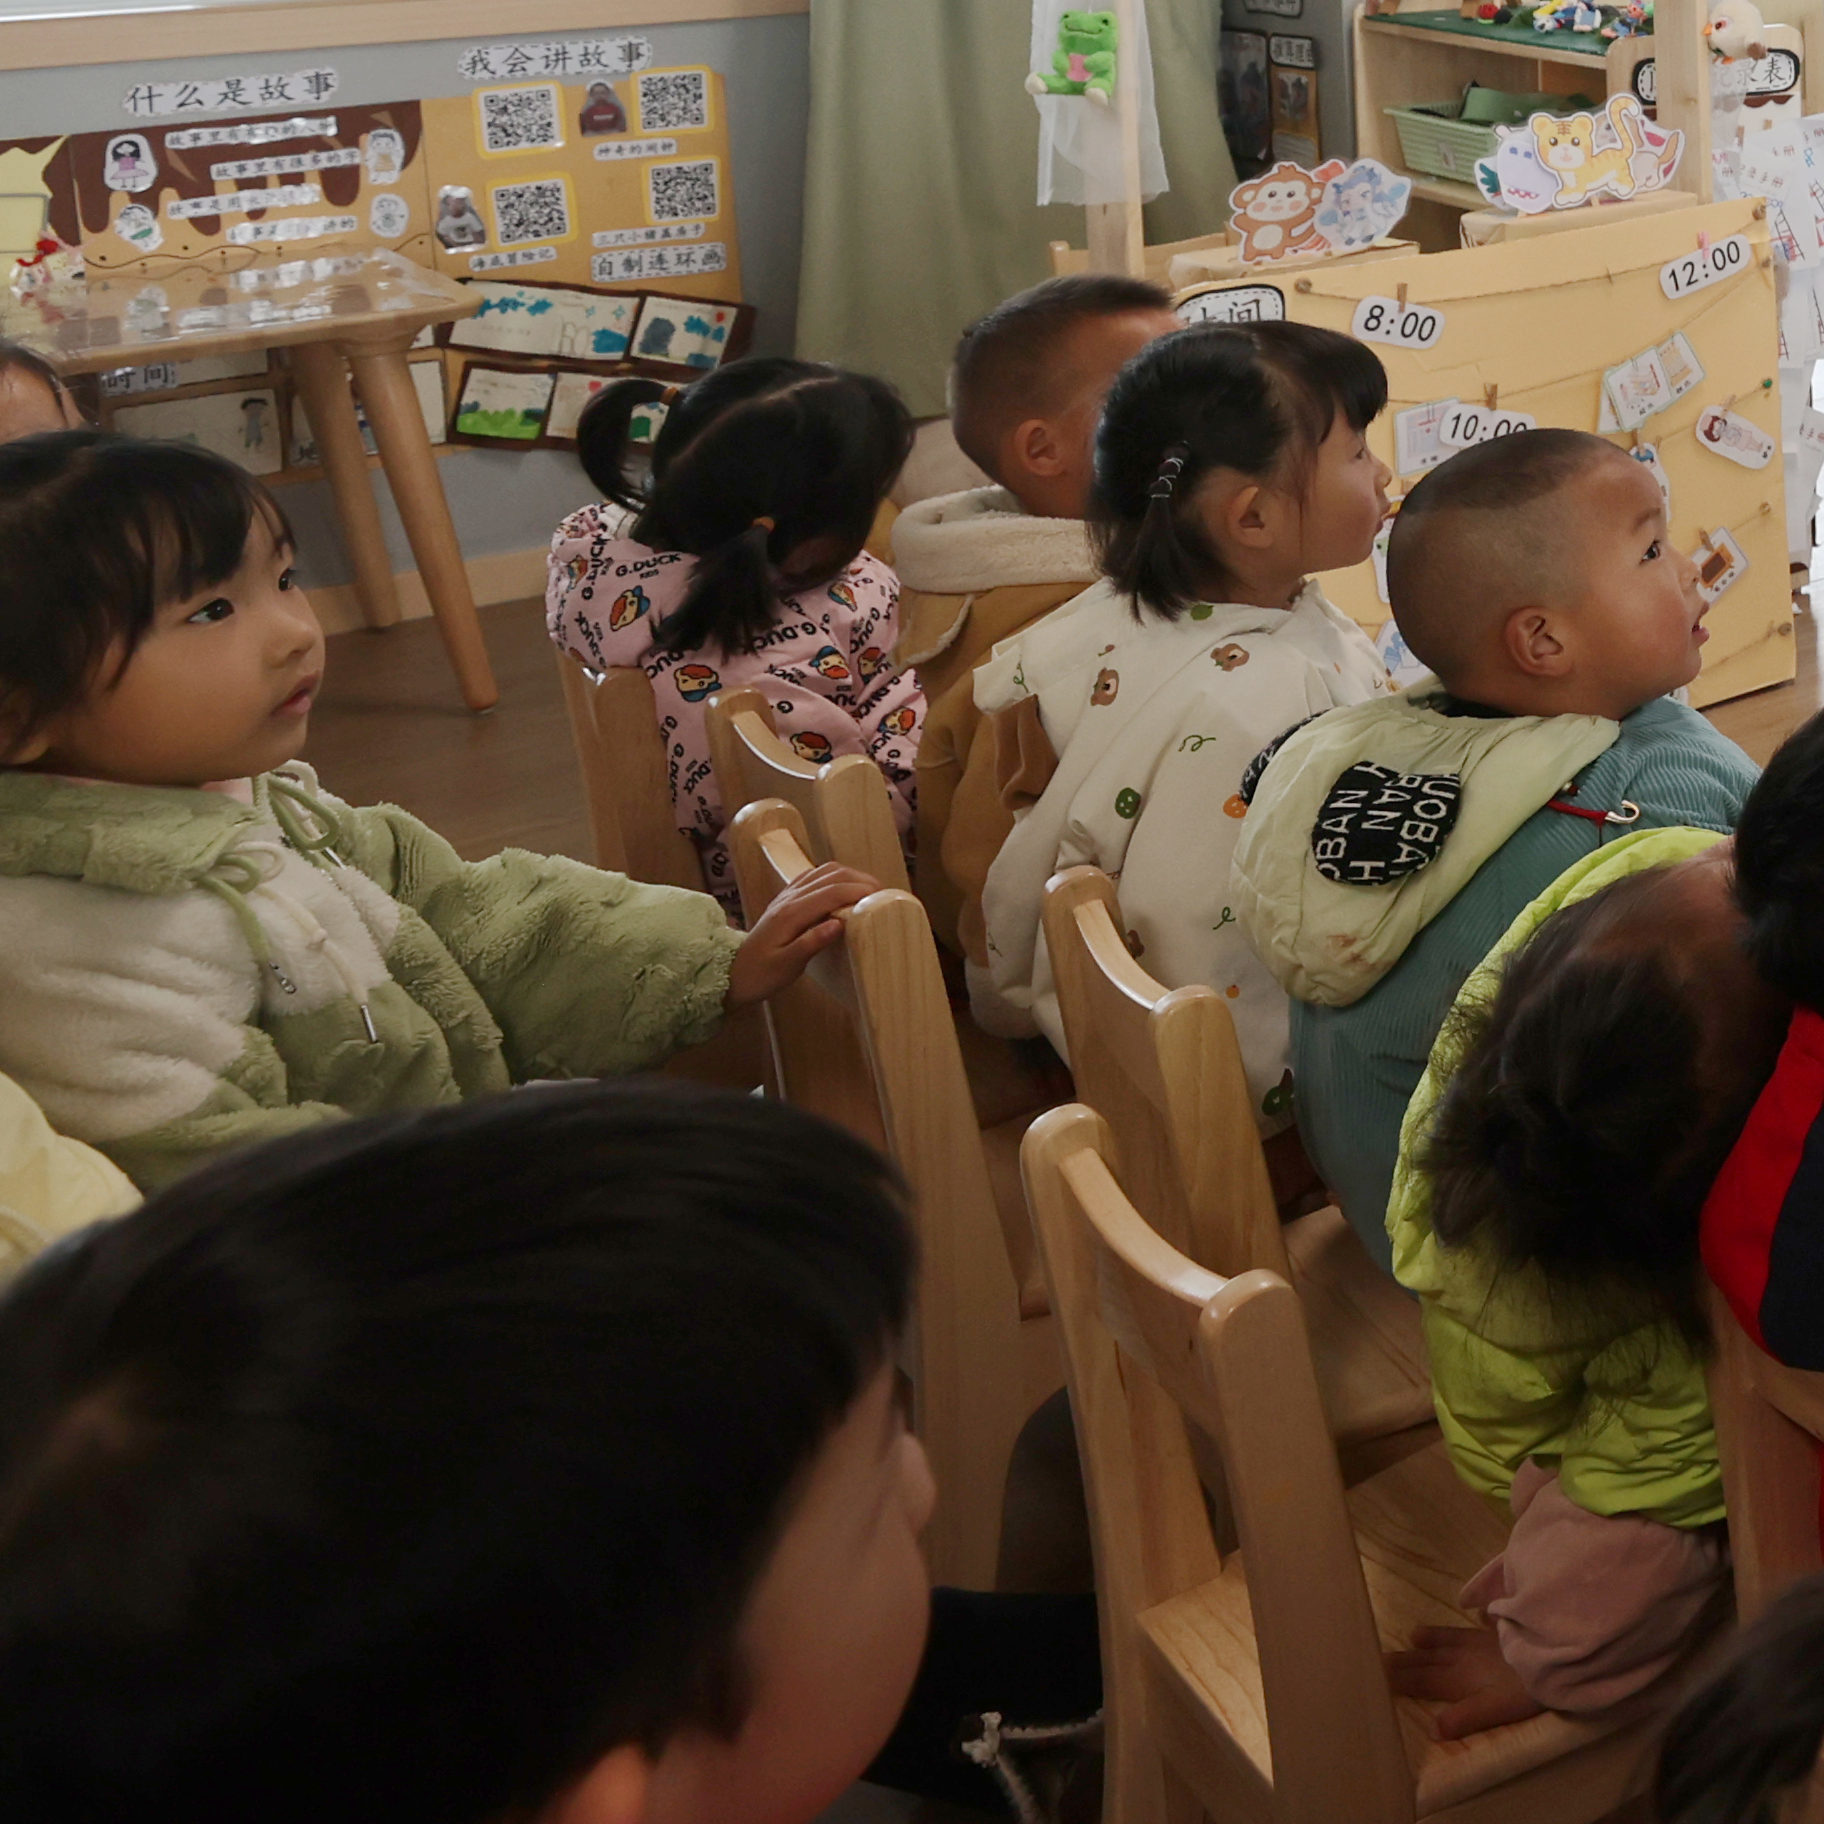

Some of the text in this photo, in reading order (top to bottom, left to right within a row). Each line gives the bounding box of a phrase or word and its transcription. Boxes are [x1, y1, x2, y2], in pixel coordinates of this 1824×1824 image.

[464, 41, 646, 76] 我会讲故事
[127, 72, 334, 114] 什么是故事
[599, 250, 722, 277] 自制连环画
[1668, 240, 1741, 292] 12:00
[1363, 304, 1436, 342] 8:00
[615, 552, 682, 578] G.DUCK
